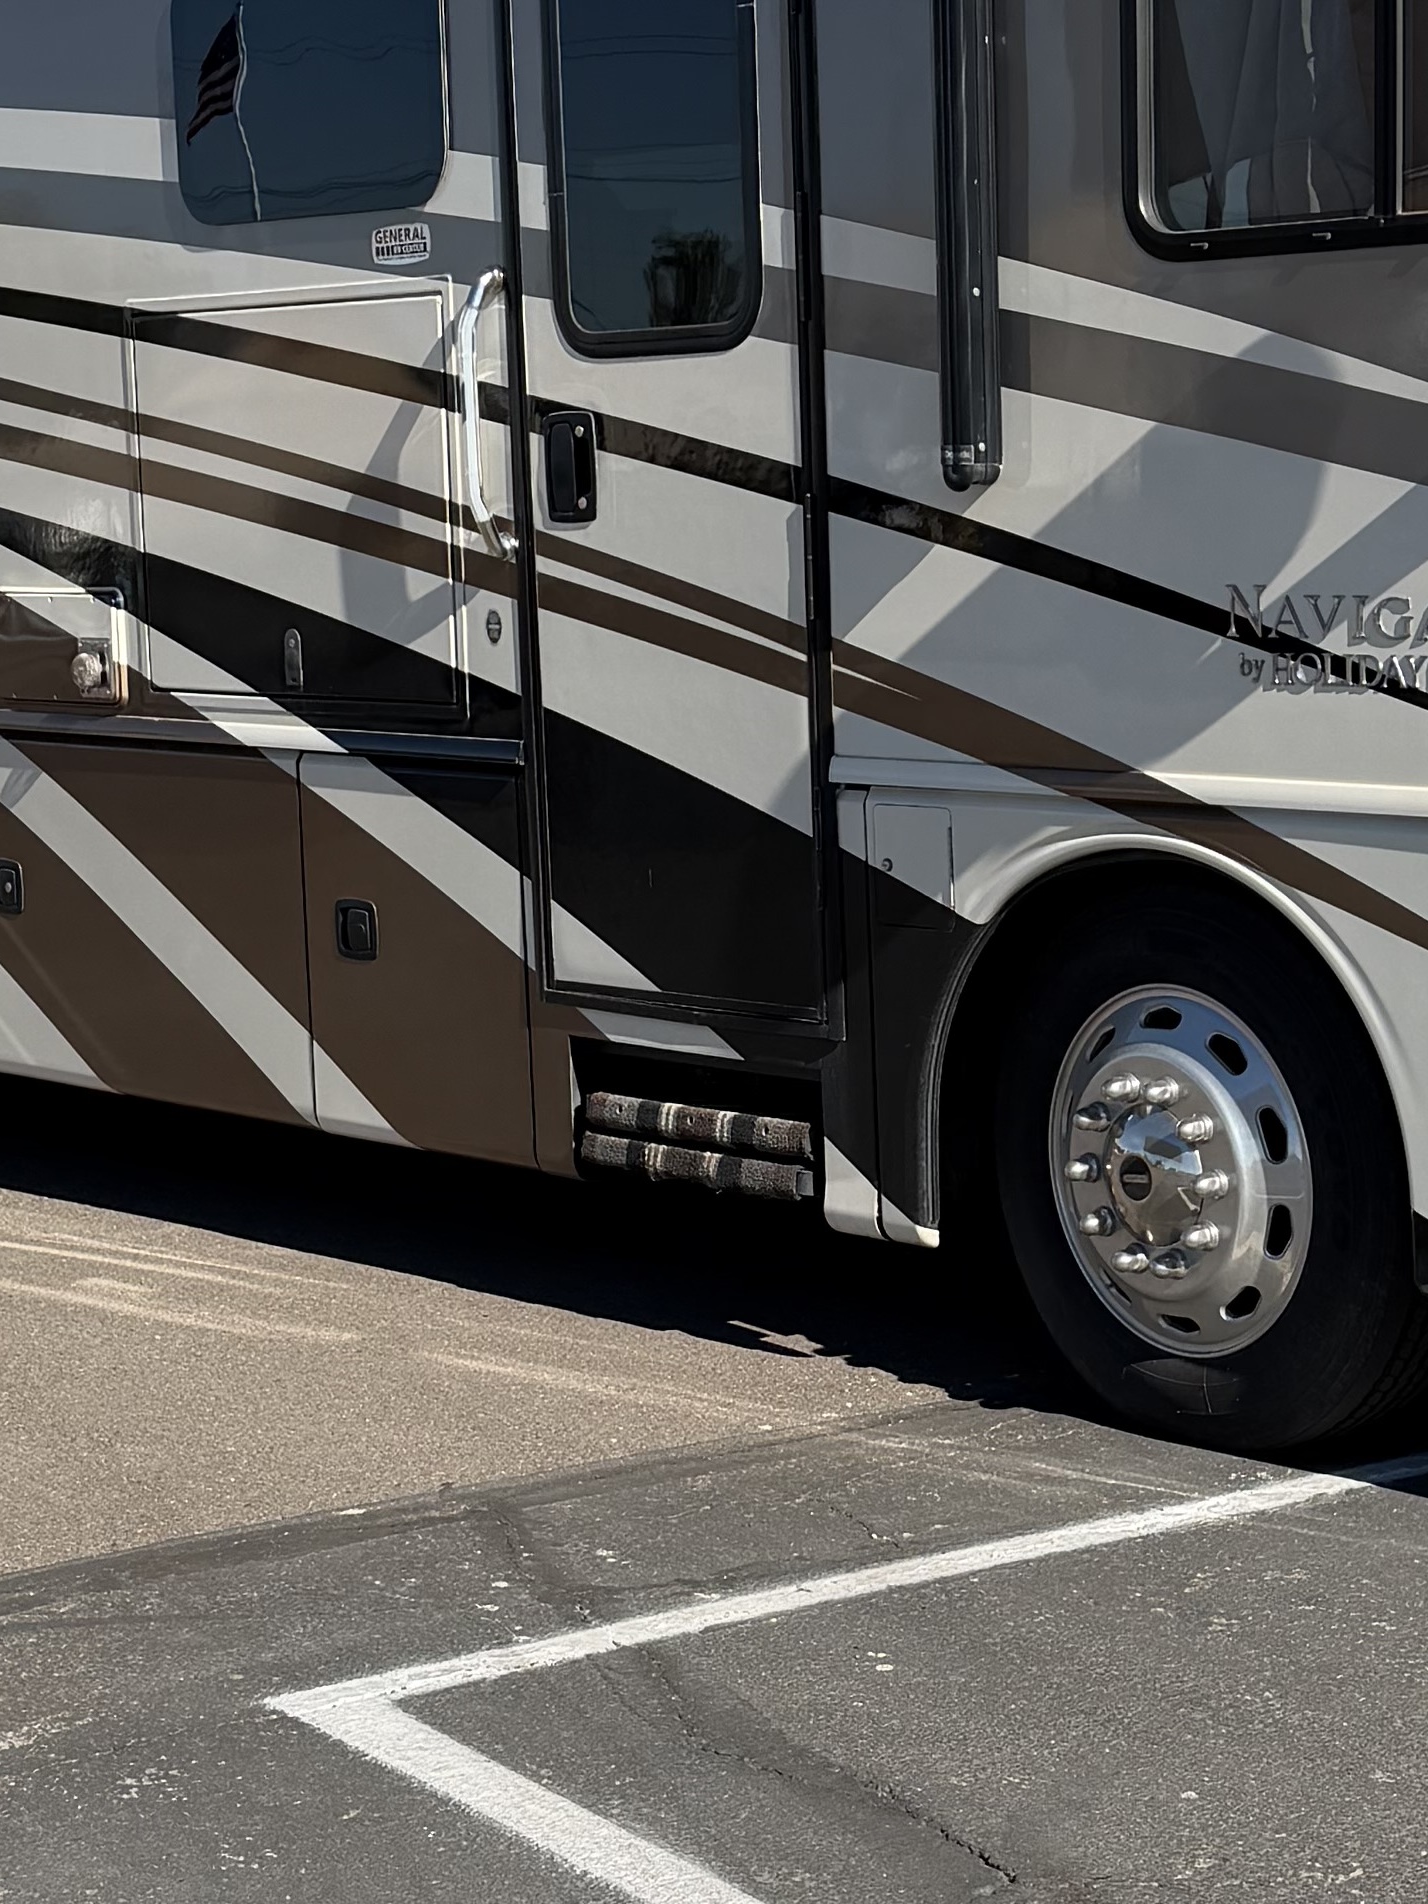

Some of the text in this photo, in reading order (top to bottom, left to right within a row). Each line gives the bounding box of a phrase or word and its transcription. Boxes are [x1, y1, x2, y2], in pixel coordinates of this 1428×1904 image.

[375, 225, 427, 244] GENERAL
[1238, 651, 1265, 684] by
[1272, 652, 1428, 689] HOLIDAY
